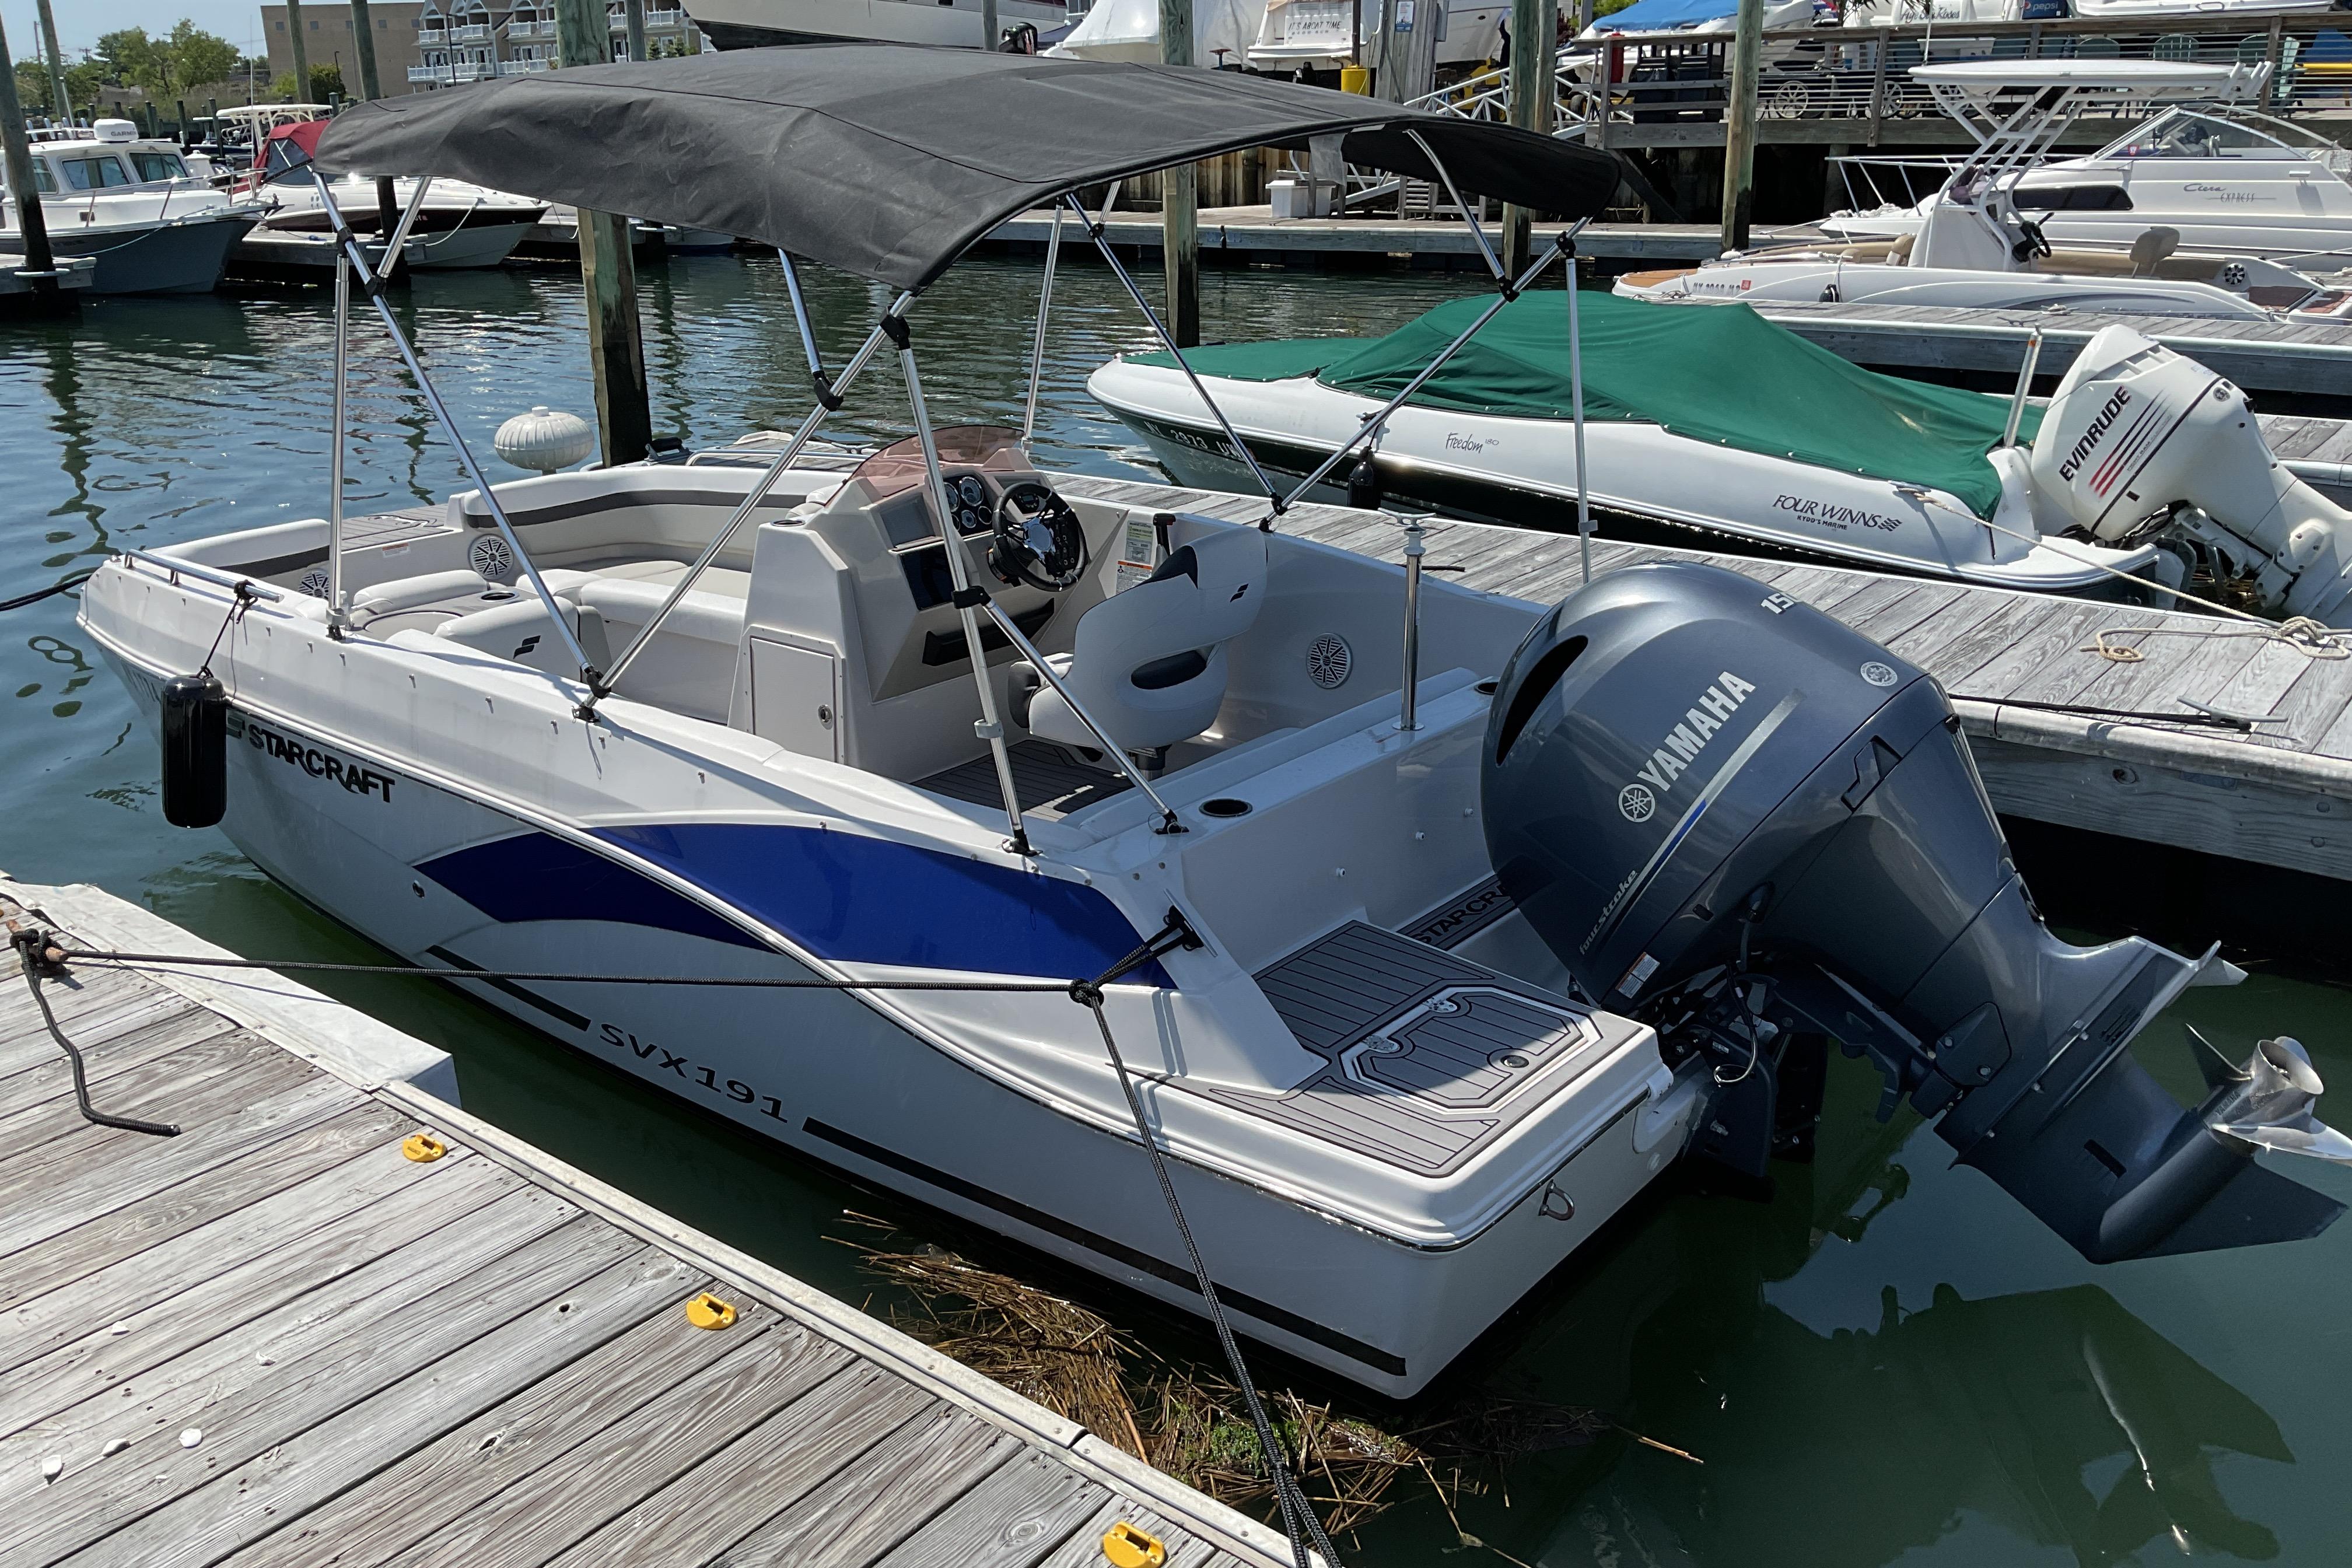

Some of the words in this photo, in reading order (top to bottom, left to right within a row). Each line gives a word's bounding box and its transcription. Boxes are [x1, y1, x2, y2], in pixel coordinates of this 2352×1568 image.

[2033, 2, 2059, 12] pepsi
[1326, 21, 1342, 29] TIME
[2221, 192, 2255, 202] EXPRESS
[1170, 429, 1208, 449] 2973
[1446, 432, 1483, 454] Freedom
[2059, 386, 2132, 481] EVINRUDE
[1772, 495, 1818, 515] FOUR
[1821, 504, 1882, 527] WINNS
[1797, 515, 1821, 524] KYDD'S
[1822, 521, 1847, 530] MARINE
[1761, 590, 1796, 614] 15
[1637, 671, 1756, 791] YAMAHA
[249, 724, 395, 803] STARCRAFT
[600, 1023, 788, 1124] SVX191
